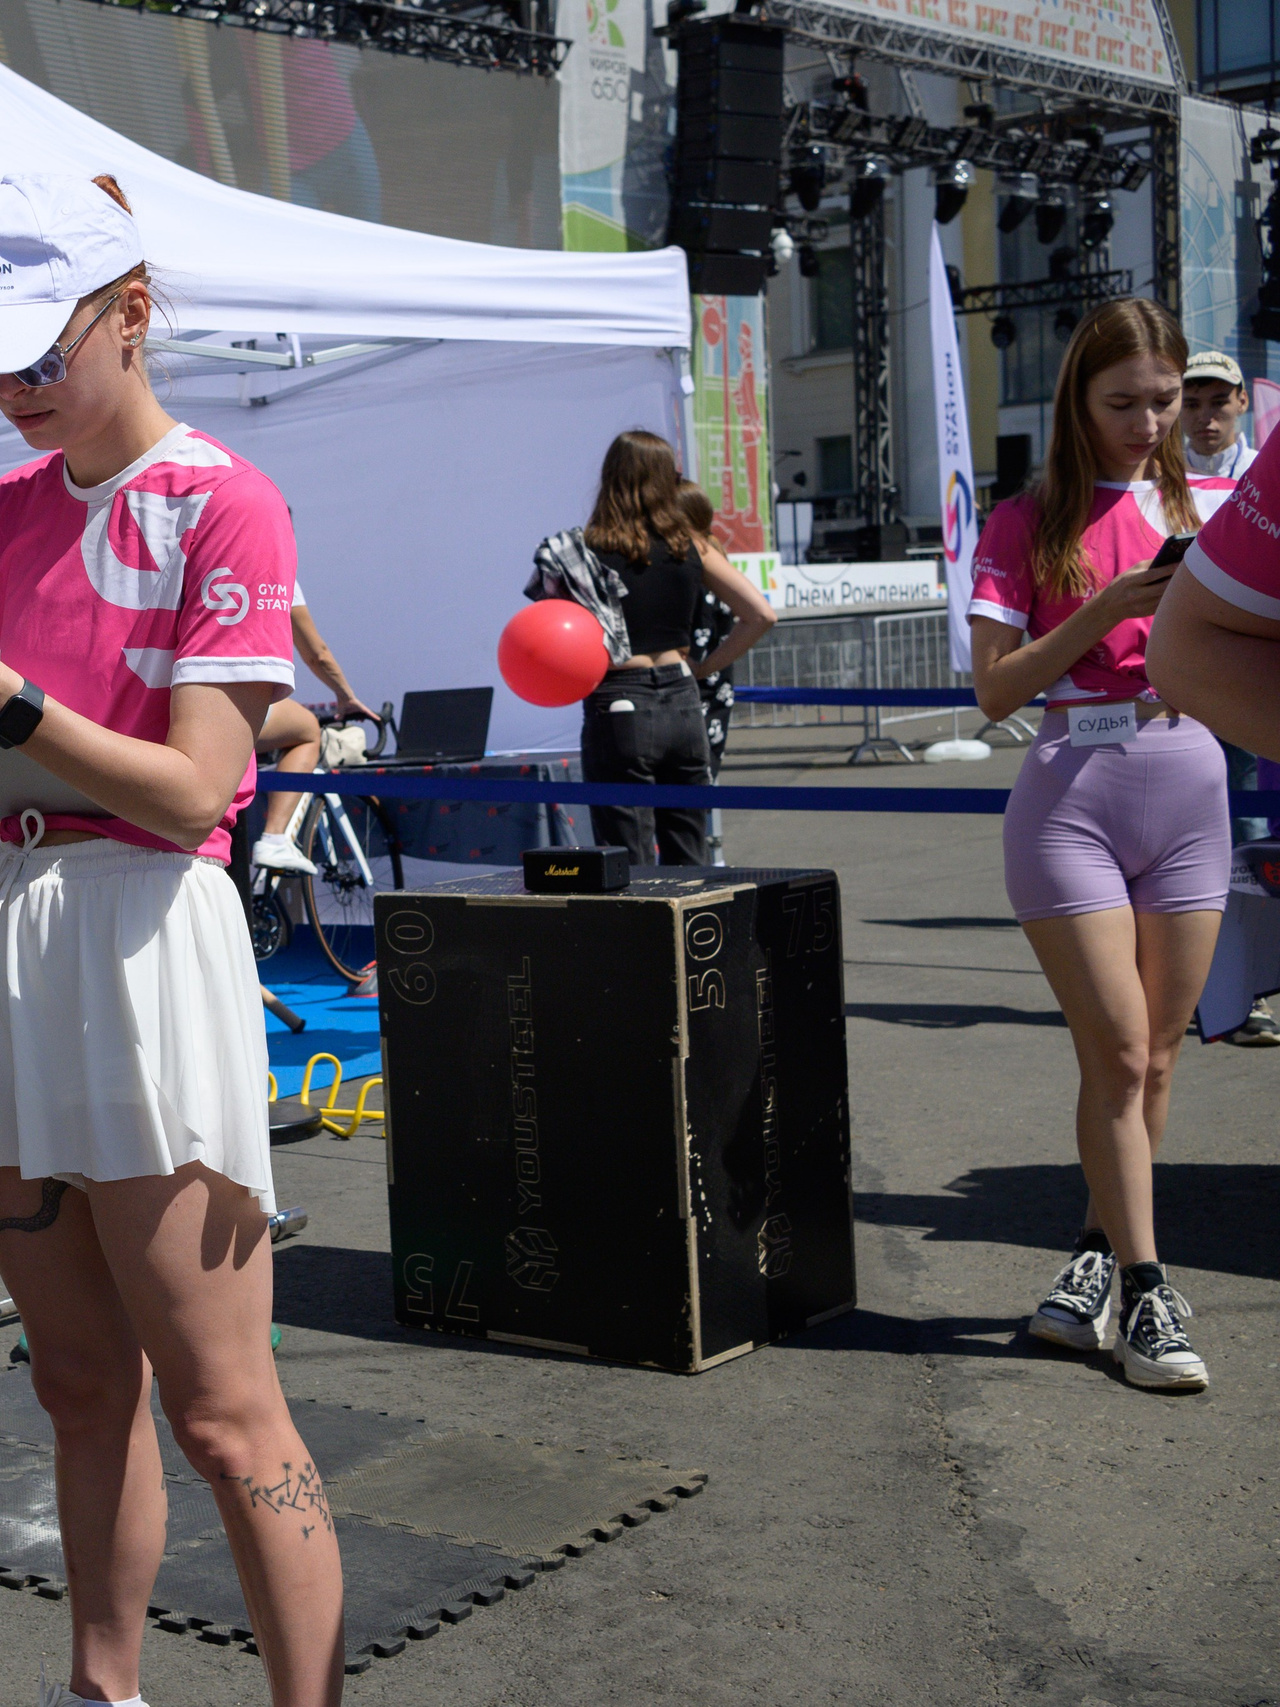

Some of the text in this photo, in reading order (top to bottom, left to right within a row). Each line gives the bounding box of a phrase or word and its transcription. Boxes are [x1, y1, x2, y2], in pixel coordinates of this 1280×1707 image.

[591, 77, 628, 102] 650
[258, 583, 287, 597] GYM
[840, 582, 929, 605] Рождения
[1078, 715, 1129, 733] СУДЬЯ
[544, 864, 580, 876] Marshall
[385, 910, 437, 1005] 60
[782, 888, 835, 958] 75
[686, 911, 726, 1012] 50
[507, 956, 543, 1215] YOUSTEEL
[756, 947, 783, 1207] YOUSTEEL
[403, 1253, 479, 1322] 75
